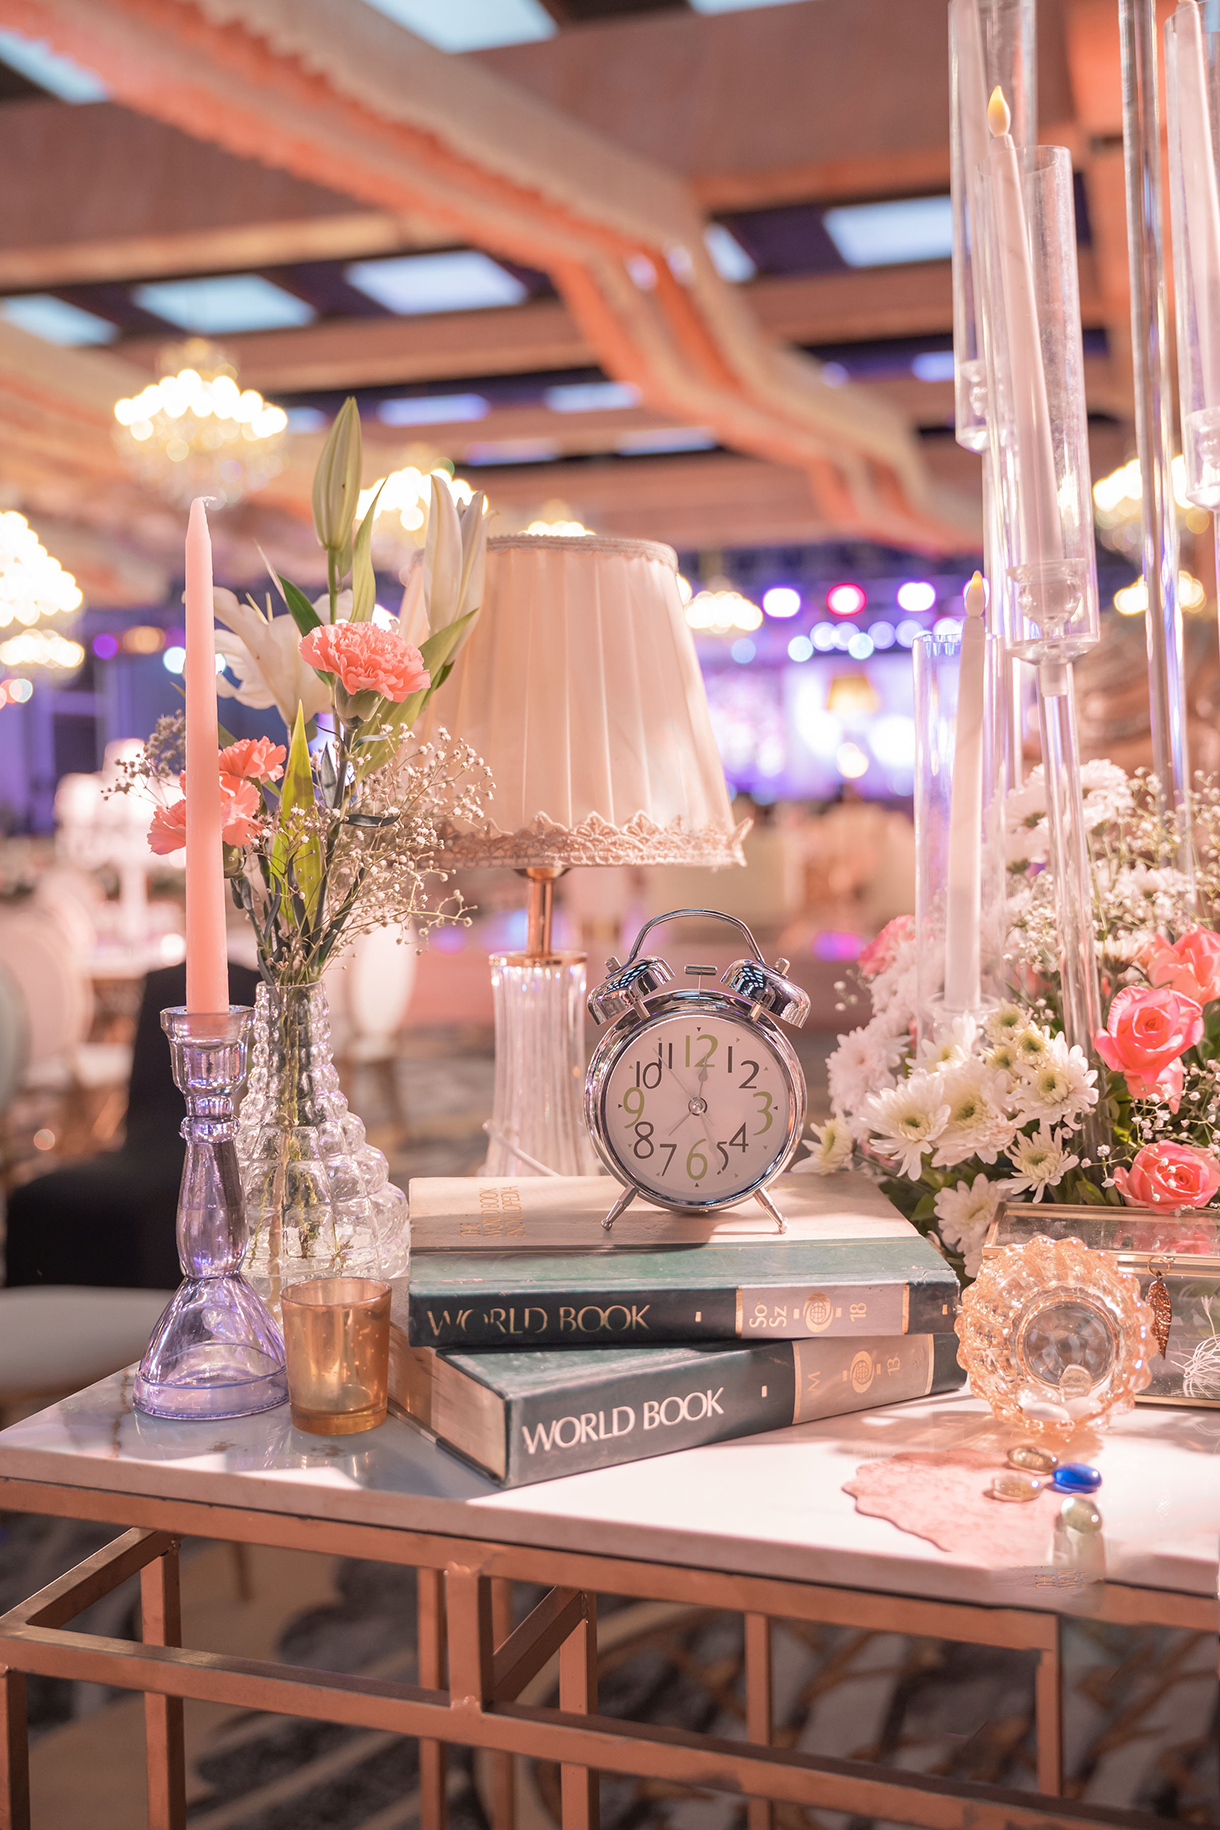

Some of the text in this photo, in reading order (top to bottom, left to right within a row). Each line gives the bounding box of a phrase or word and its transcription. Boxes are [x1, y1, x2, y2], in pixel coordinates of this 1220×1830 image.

[658, 1042, 673, 1070] 11
[685, 1034, 718, 1068] 12
[727, 1046, 733, 1073] 1
[635, 1061, 662, 1089] 10
[738, 1060, 760, 1089] 2
[623, 1087, 645, 1129] 9
[752, 1091, 773, 1136] 3
[633, 1121, 655, 1159] 8
[729, 1122, 749, 1153] 4
[659, 1143, 678, 1177] 7
[686, 1138, 708, 1181] 6
[716, 1141, 730, 1176] 5
[479, 1187, 503, 1237] WORLD BOOK
[460, 1222, 480, 1237] THE
[559, 1304, 651, 1333] BOOK
[769, 1305, 787, 1327] Sz
[850, 1302, 867, 1322] 18
[807, 1371, 821, 1391] M
[887, 1356, 901, 1378] 13
[522, 1387, 724, 1454] WORLD BOOK
